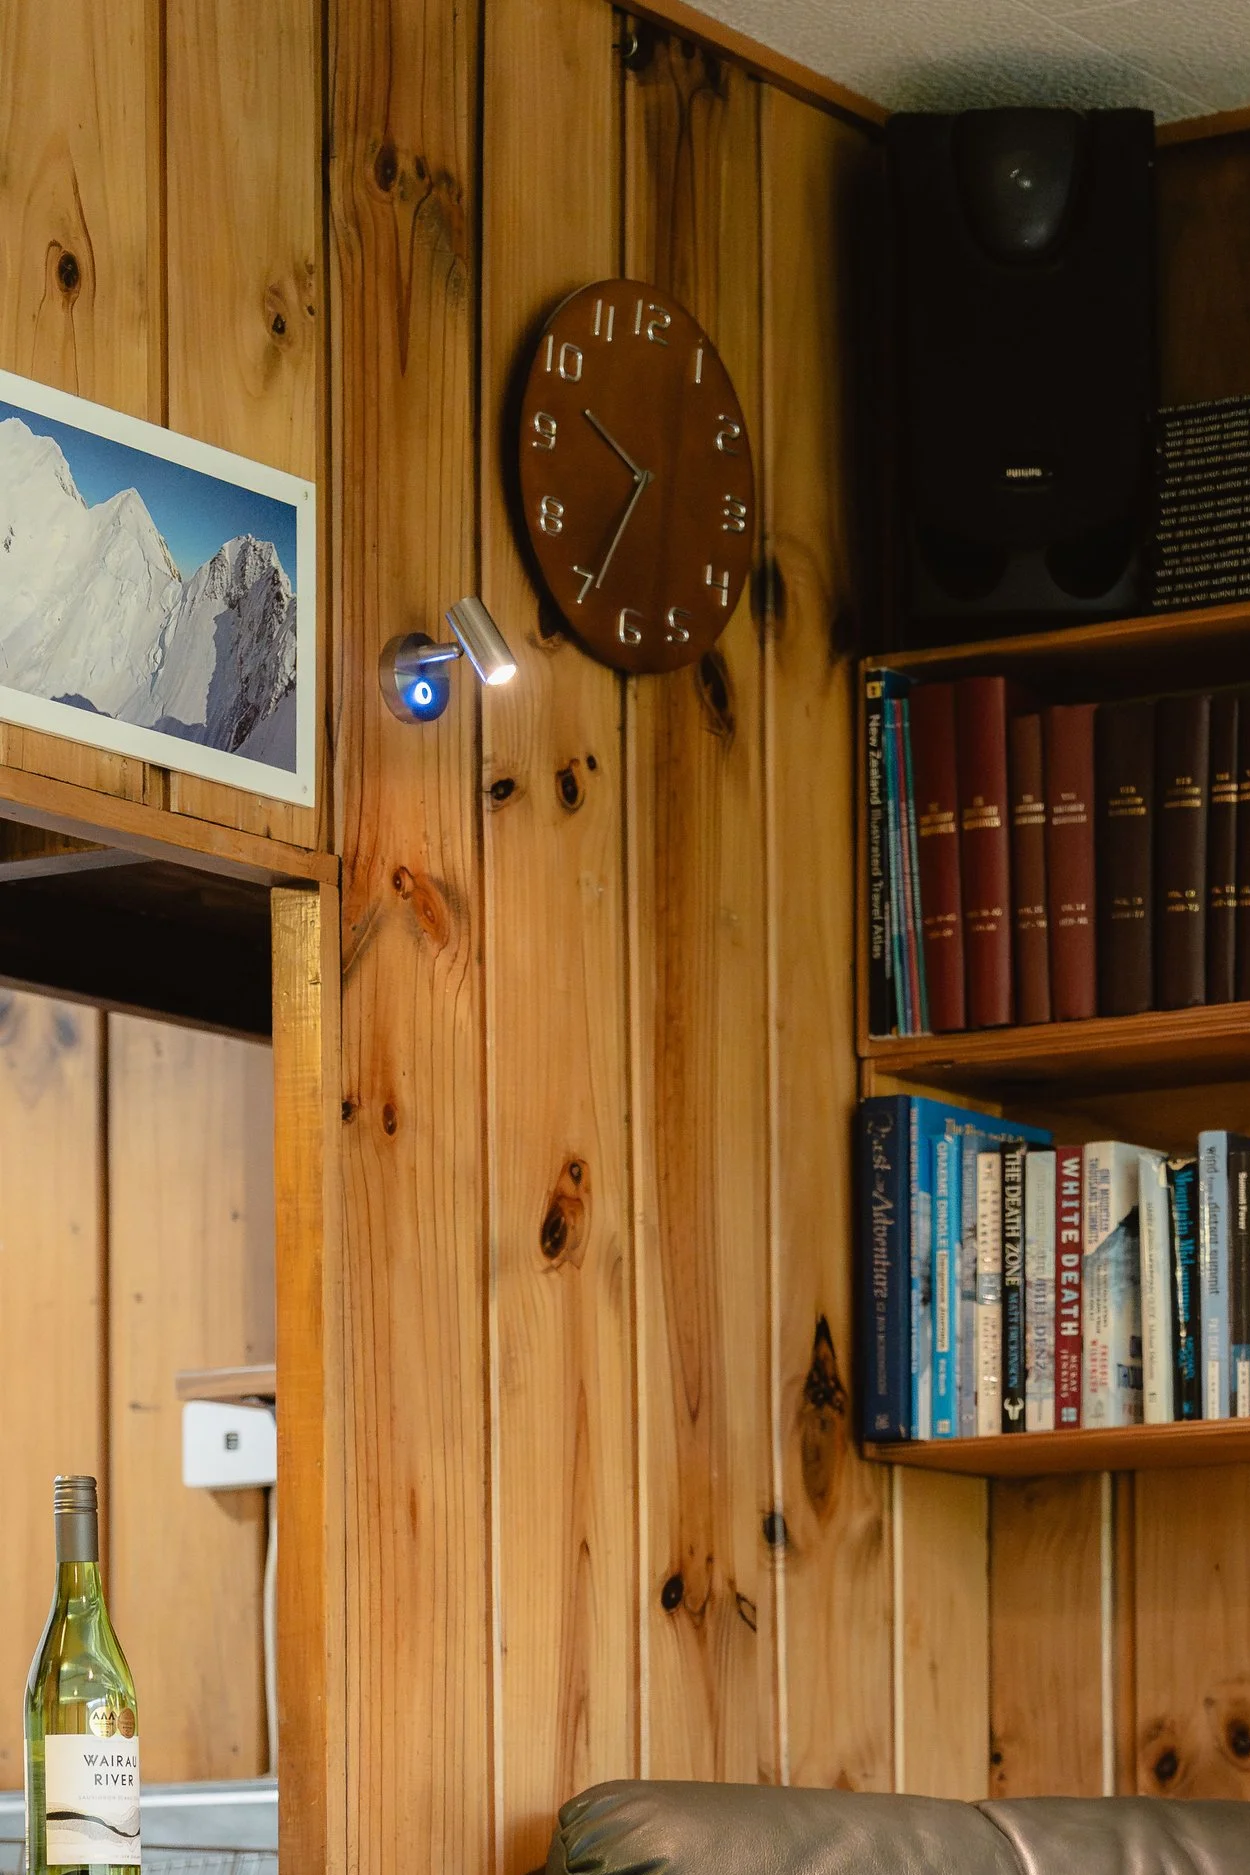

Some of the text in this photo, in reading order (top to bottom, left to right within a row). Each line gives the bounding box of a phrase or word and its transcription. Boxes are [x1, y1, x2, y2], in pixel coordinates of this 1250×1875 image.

[593, 299, 614, 342] 11
[634, 299, 672, 346] 12
[545, 334, 582, 382] 10
[695, 347, 704, 384] 1
[532, 411, 557, 450] 9
[716, 414, 742, 454] 2
[539, 495, 564, 536] 8
[722, 494, 746, 533] 3
[572, 565, 595, 604] 7
[706, 564, 730, 606] 4
[619, 608, 643, 645] 6
[666, 606, 690, 643] 5
[867, 714, 886, 959] New Zealand Illustrated Travel Atlas
[1002, 1152, 1023, 1286] THE DEATH ZONE
[1173, 1170, 1194, 1236] Mountain
[1205, 1146, 1222, 1296] wind distant summit
[1237, 1172, 1248, 1230] Summit Fever
[870, 1191, 896, 1300] Adventure
[1060, 1157, 1080, 1336] WHITE DEATH
[1060, 1349, 1070, 1398] JENKINS
[84, 1754, 137, 1768] WAIRAU
[94, 1774, 134, 1787] RIVER
